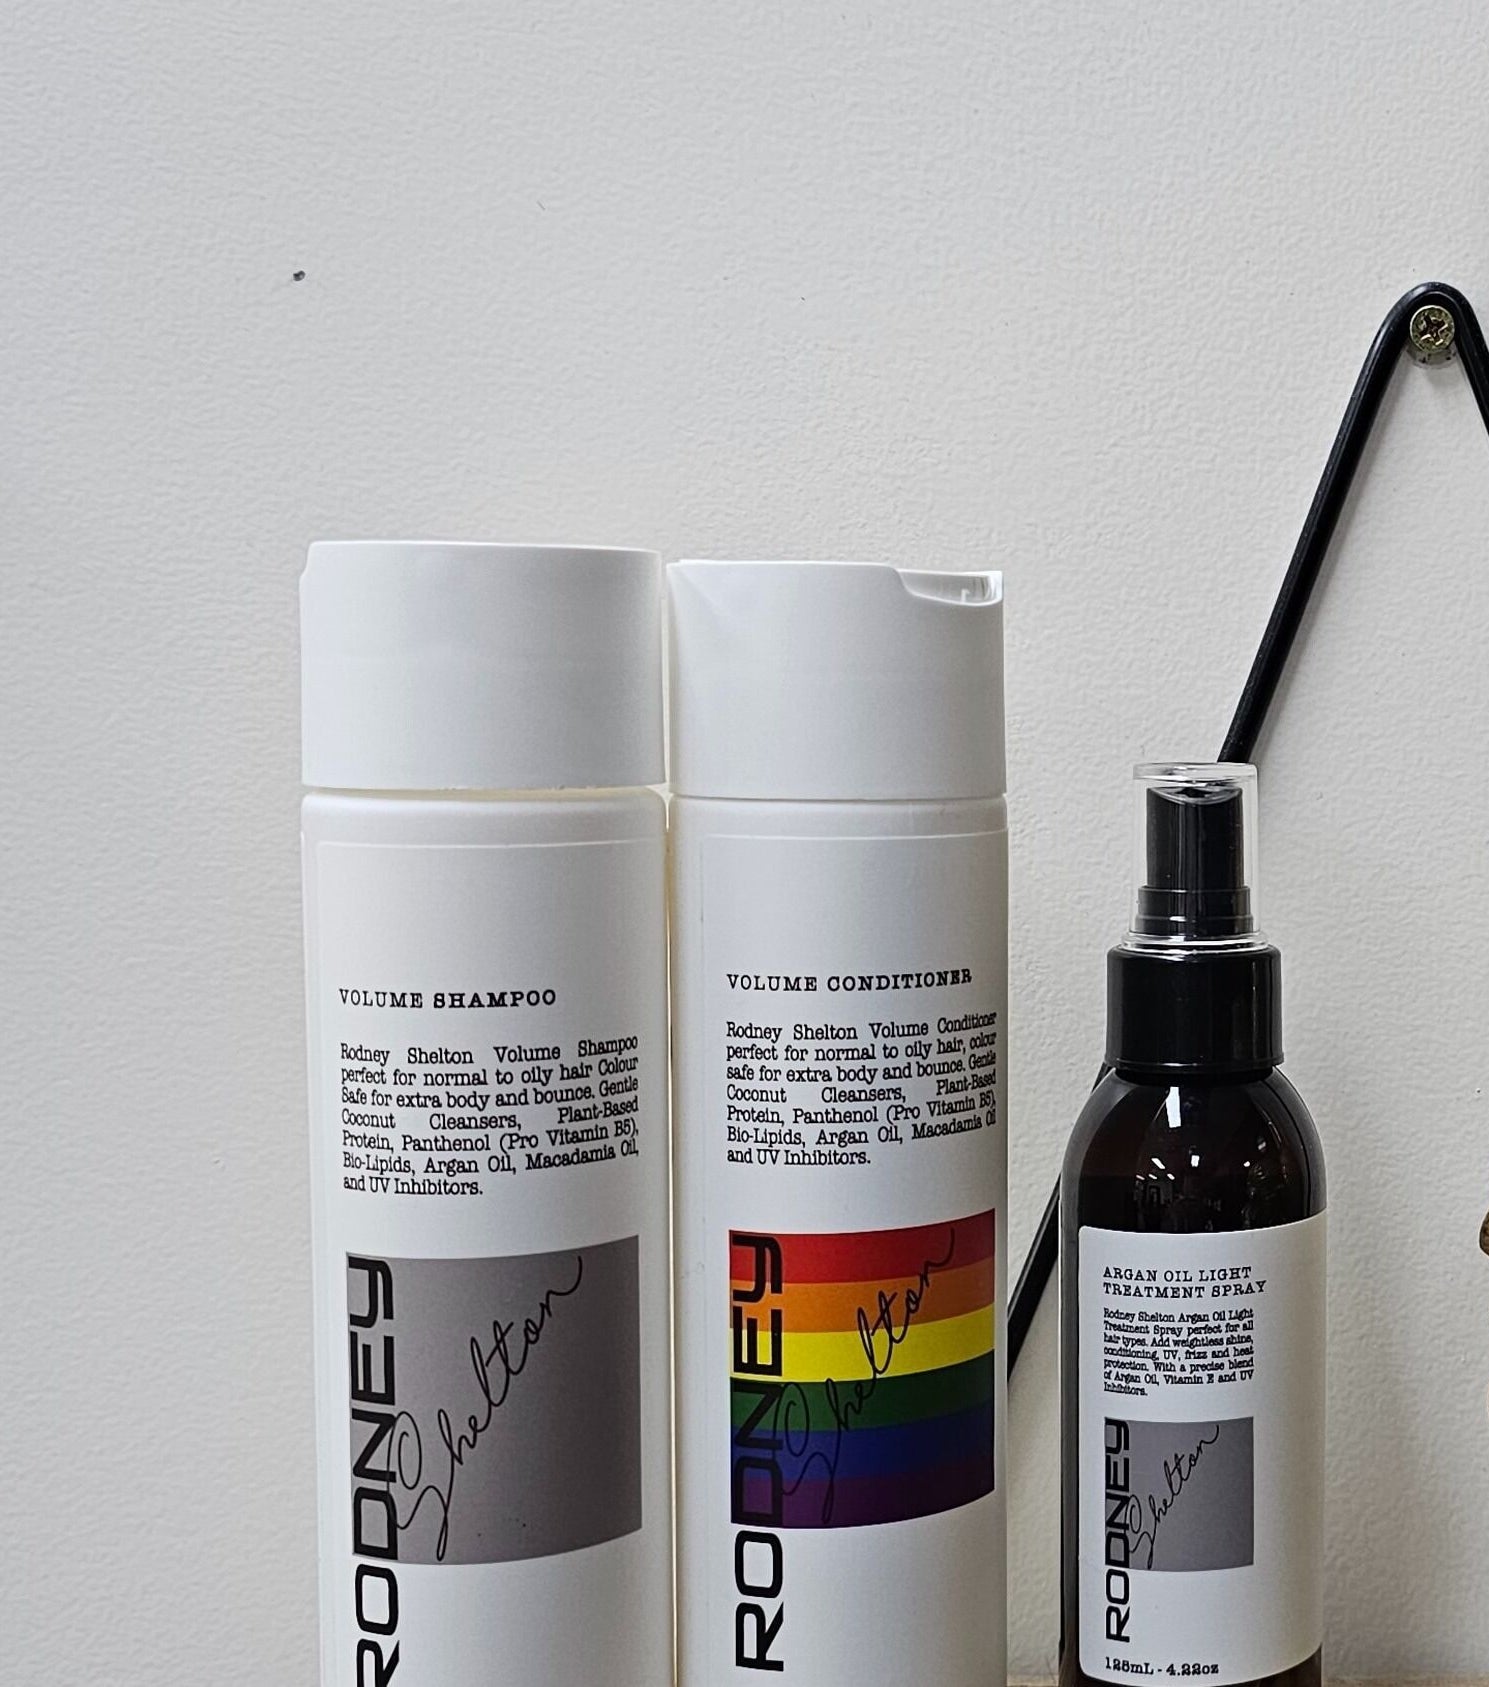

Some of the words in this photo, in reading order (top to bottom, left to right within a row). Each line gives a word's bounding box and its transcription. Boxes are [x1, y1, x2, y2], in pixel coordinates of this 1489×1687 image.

[726, 973, 818, 992] VOLUME
[827, 968, 972, 992] CONDITIONER
[339, 988, 423, 1009] VOLUME
[433, 989, 557, 1009] SHAMPOO
[726, 1021, 782, 1043] Rodney
[793, 1024, 858, 1041] Shelton
[868, 1021, 929, 1039] Volume
[937, 1011, 997, 1034] Conditioner
[340, 1042, 390, 1065] Rodney
[407, 1047, 474, 1065] Shelton
[493, 1045, 561, 1064] Volume
[578, 1035, 638, 1057] Shampoo
[726, 1044, 778, 1062] perfect
[784, 1046, 809, 1061] for
[814, 1045, 876, 1061] normal
[883, 1043, 899, 1059] to
[904, 1041, 932, 1060] oily
[937, 1037, 967, 1055] hair,
[341, 1066, 387, 1085] perfect
[393, 1069, 417, 1086] for
[423, 1070, 488, 1086] normal
[495, 1069, 514, 1085] to
[520, 1066, 554, 1086] oily
[560, 1063, 593, 1080] hair
[598, 1056, 639, 1077] Colour
[726, 1065, 754, 1081] safe
[759, 1066, 782, 1082] for
[786, 1068, 832, 1083] extra
[836, 1065, 877, 1084] body
[882, 1064, 912, 1080] and
[916, 1059, 966, 1078] bounce.
[341, 1087, 367, 1105] Safe
[371, 1090, 392, 1107] for
[396, 1093, 443, 1108] extra
[446, 1091, 490, 1111] body
[495, 1089, 529, 1106] and
[533, 1085, 595, 1105] bounce.
[599, 1076, 639, 1097] Gentle
[726, 1084, 787, 1103] Coconut
[821, 1087, 907, 1104] Cleansers,
[936, 1069, 997, 1096] Plant-Based
[341, 1108, 396, 1129] Coconut
[429, 1114, 522, 1131] Cleansers,
[556, 1097, 639, 1124] Plant-Based
[726, 1105, 785, 1127] Protein,
[792, 1107, 878, 1124] Panthenol
[886, 1105, 921, 1125] (Pro
[926, 1096, 976, 1117] Vitamin
[342, 1130, 394, 1152] Protein,
[401, 1133, 491, 1151] Panthenol
[500, 1132, 539, 1154] (Pro
[546, 1126, 609, 1147] Vitamin
[613, 1117, 639, 1137] B5),
[726, 1126, 806, 1148] Bio-Lipids,
[815, 1128, 869, 1147] Argan
[877, 1127, 904, 1144] Oil,
[911, 1117, 983, 1140] Macadamia
[343, 1152, 416, 1174] Bio-Lipids,
[423, 1158, 479, 1177] Argan
[487, 1154, 517, 1175] Oil,
[525, 1146, 616, 1170] Macadamia
[620, 1138, 639, 1157] Oil,
[726, 1149, 753, 1164] and
[757, 1149, 779, 1165] UV
[784, 1150, 871, 1166] Inhibitors.
[343, 1175, 366, 1192] and
[369, 1177, 390, 1194] UV
[394, 1178, 483, 1195] Inhibitors.
[1103, 1266, 1158, 1282] ARGAN
[1164, 1270, 1193, 1282] OIL
[1198, 1266, 1252, 1281] LIGHT
[1103, 1282, 1206, 1298] TREATMENT
[1211, 1280, 1267, 1298] SPRAY
[1103, 1307, 1136, 1323] Rodney
[1138, 1311, 1175, 1323] Shelton
[1178, 1312, 1210, 1324] Argan
[1212, 1310, 1226, 1321] Oil
[1228, 1308, 1254, 1321] Light
[1103, 1320, 1150, 1334] Treatment
[1153, 1324, 1183, 1337] Spray
[1187, 1324, 1223, 1336] perfect
[1224, 1322, 1240, 1333] for
[1242, 1320, 1254, 1331] all
[1103, 1332, 1121, 1343] hair
[1122, 1336, 1148, 1348] types.
[1150, 1337, 1170, 1348] Add
[1172, 1336, 1225, 1349] weightless
[1226, 1334, 1254, 1345] shine,
[1103, 1346, 1160, 1361] conditioning,
[1163, 1350, 1181, 1362] UV,
[1184, 1349, 1208, 1360] frizz
[1211, 1348, 1230, 1358] and
[1233, 1345, 1254, 1357] heat
[777, 1226, 956, 1524] Shelton
[1103, 1358, 1149, 1372] protection.
[1153, 1362, 1176, 1372] With
[1179, 1364, 1186, 1372] a
[1189, 1361, 1225, 1374] precise
[1228, 1357, 1254, 1369] blend
[1103, 1370, 1112, 1380] of
[1114, 1373, 1141, 1384] Argan
[1144, 1373, 1160, 1386] Oil,
[1163, 1374, 1203, 1385] Vitamin
[1206, 1374, 1215, 1384] E
[1217, 1372, 1237, 1383] and
[1240, 1369, 1254, 1381] UV
[1103, 1382, 1148, 1397] Inhibitors.
[386, 1254, 584, 1562] Shelton
[730, 1231, 785, 1672] RODNEY
[345, 1254, 402, 1687] RODNEY
[1123, 1423, 1220, 1570] Shelton
[1104, 1417, 1130, 1643] RODNEY
